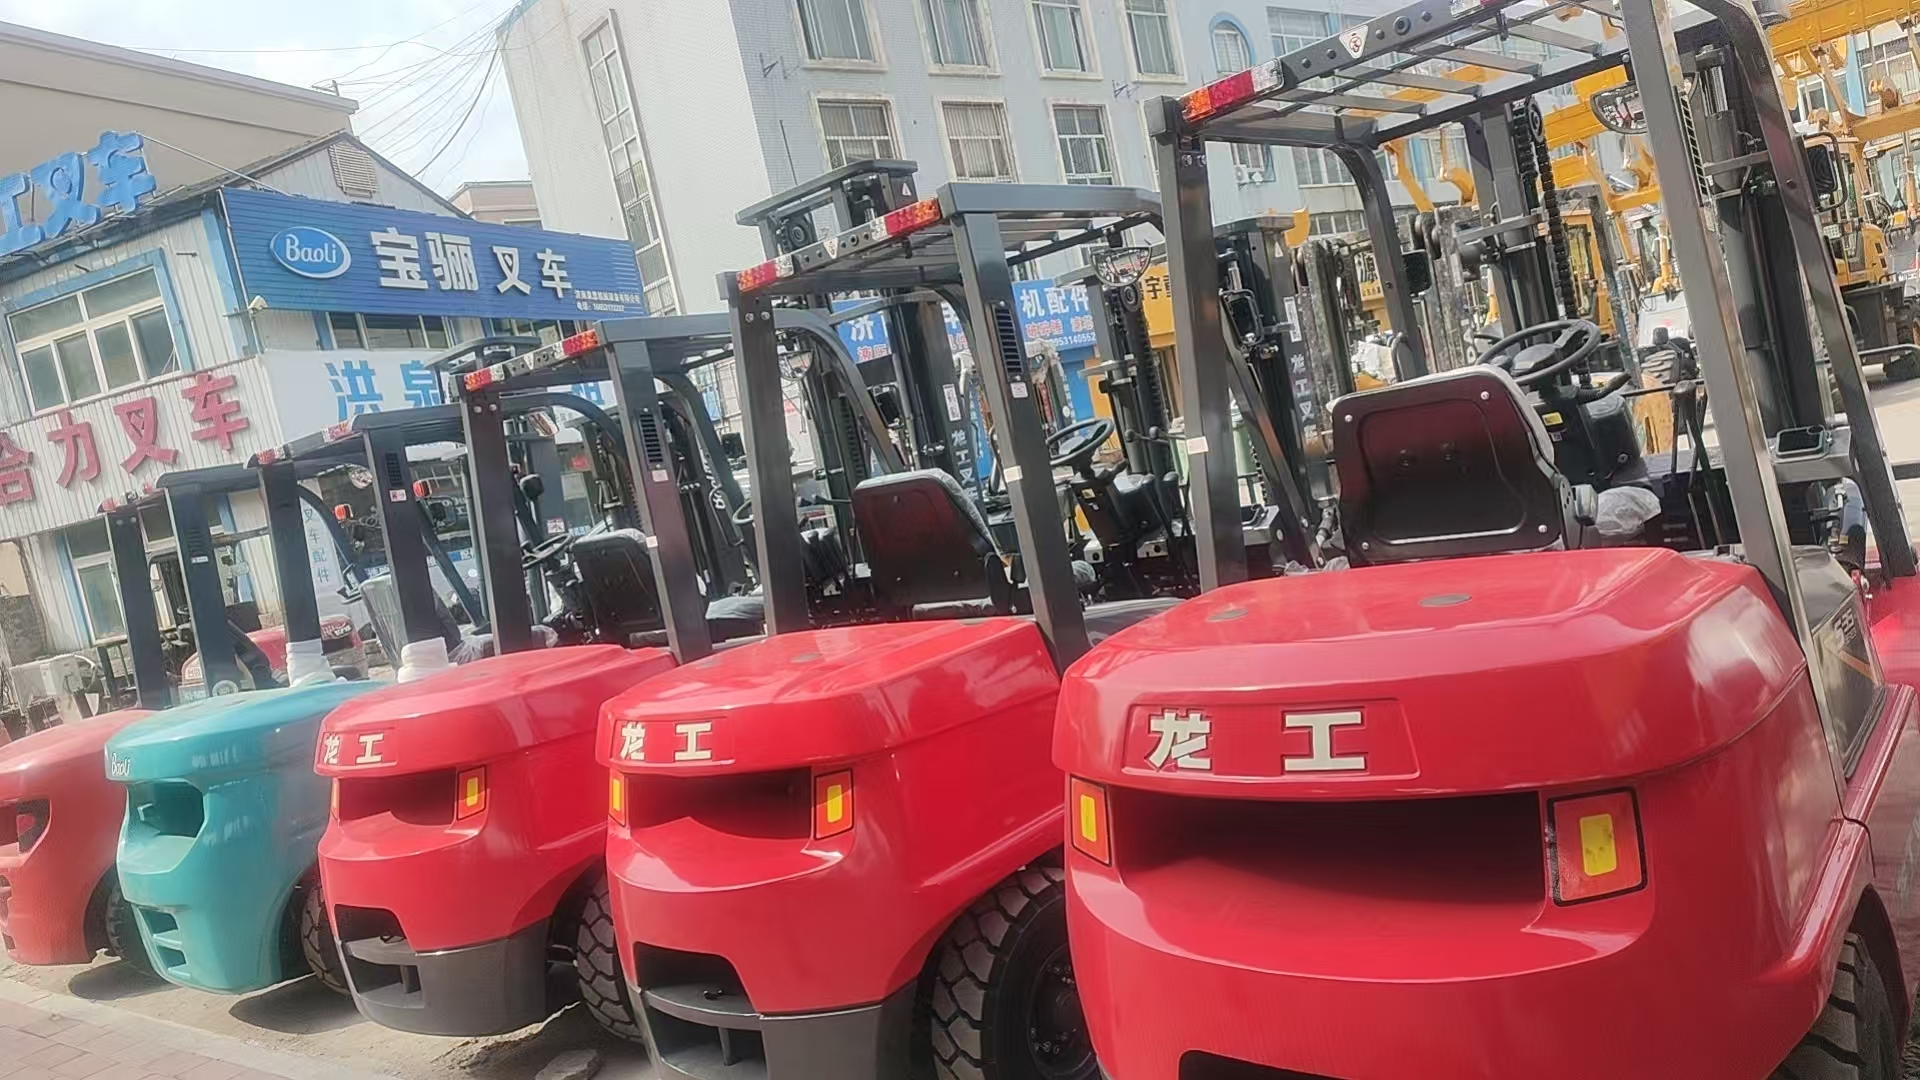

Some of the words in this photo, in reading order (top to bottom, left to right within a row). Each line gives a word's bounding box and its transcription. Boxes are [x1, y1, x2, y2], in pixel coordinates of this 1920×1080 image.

[285, 234, 336, 264] Baoli
[370, 227, 572, 298] 宝骊叉车
[1020, 286, 1090, 318] 机配件
[323, 733, 384, 764] 龙工
[620, 721, 713, 761] 龙工
[1149, 709, 1366, 773] 龙工
